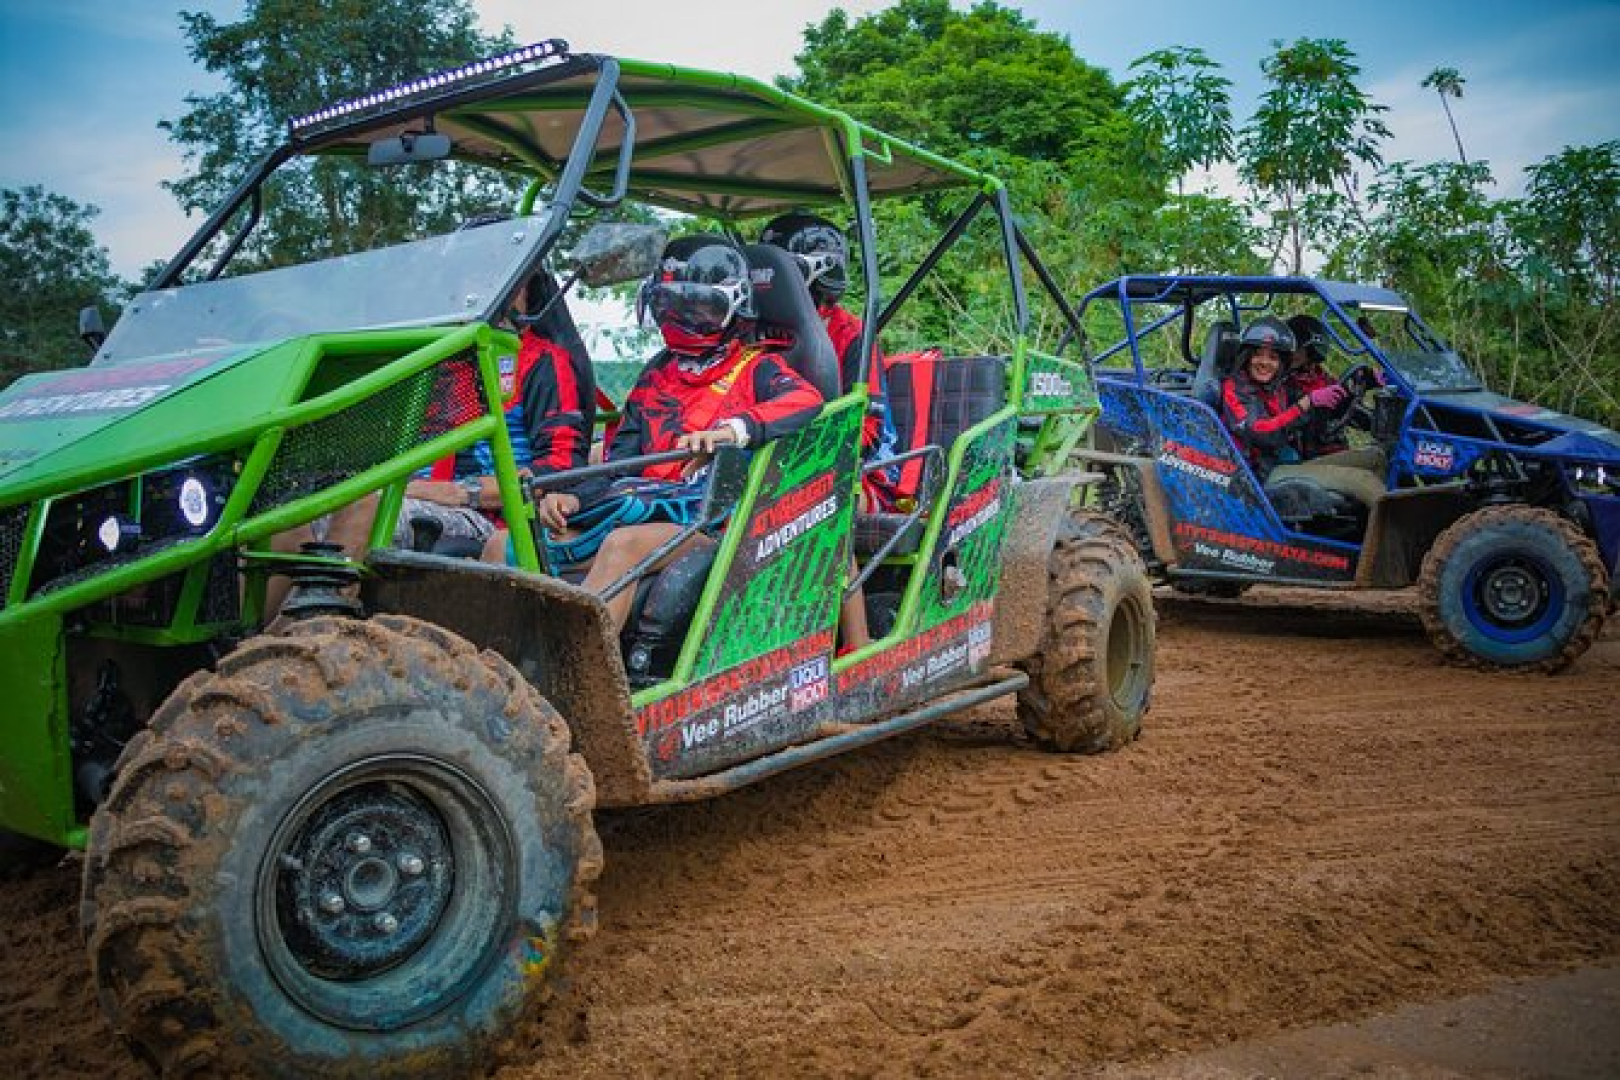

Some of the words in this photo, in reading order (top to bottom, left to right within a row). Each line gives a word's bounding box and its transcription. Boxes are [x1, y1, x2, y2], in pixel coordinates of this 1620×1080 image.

[755, 496, 836, 562] ADVENTURES
[682, 717, 720, 749] Vee
[724, 685, 788, 728] Rubber
